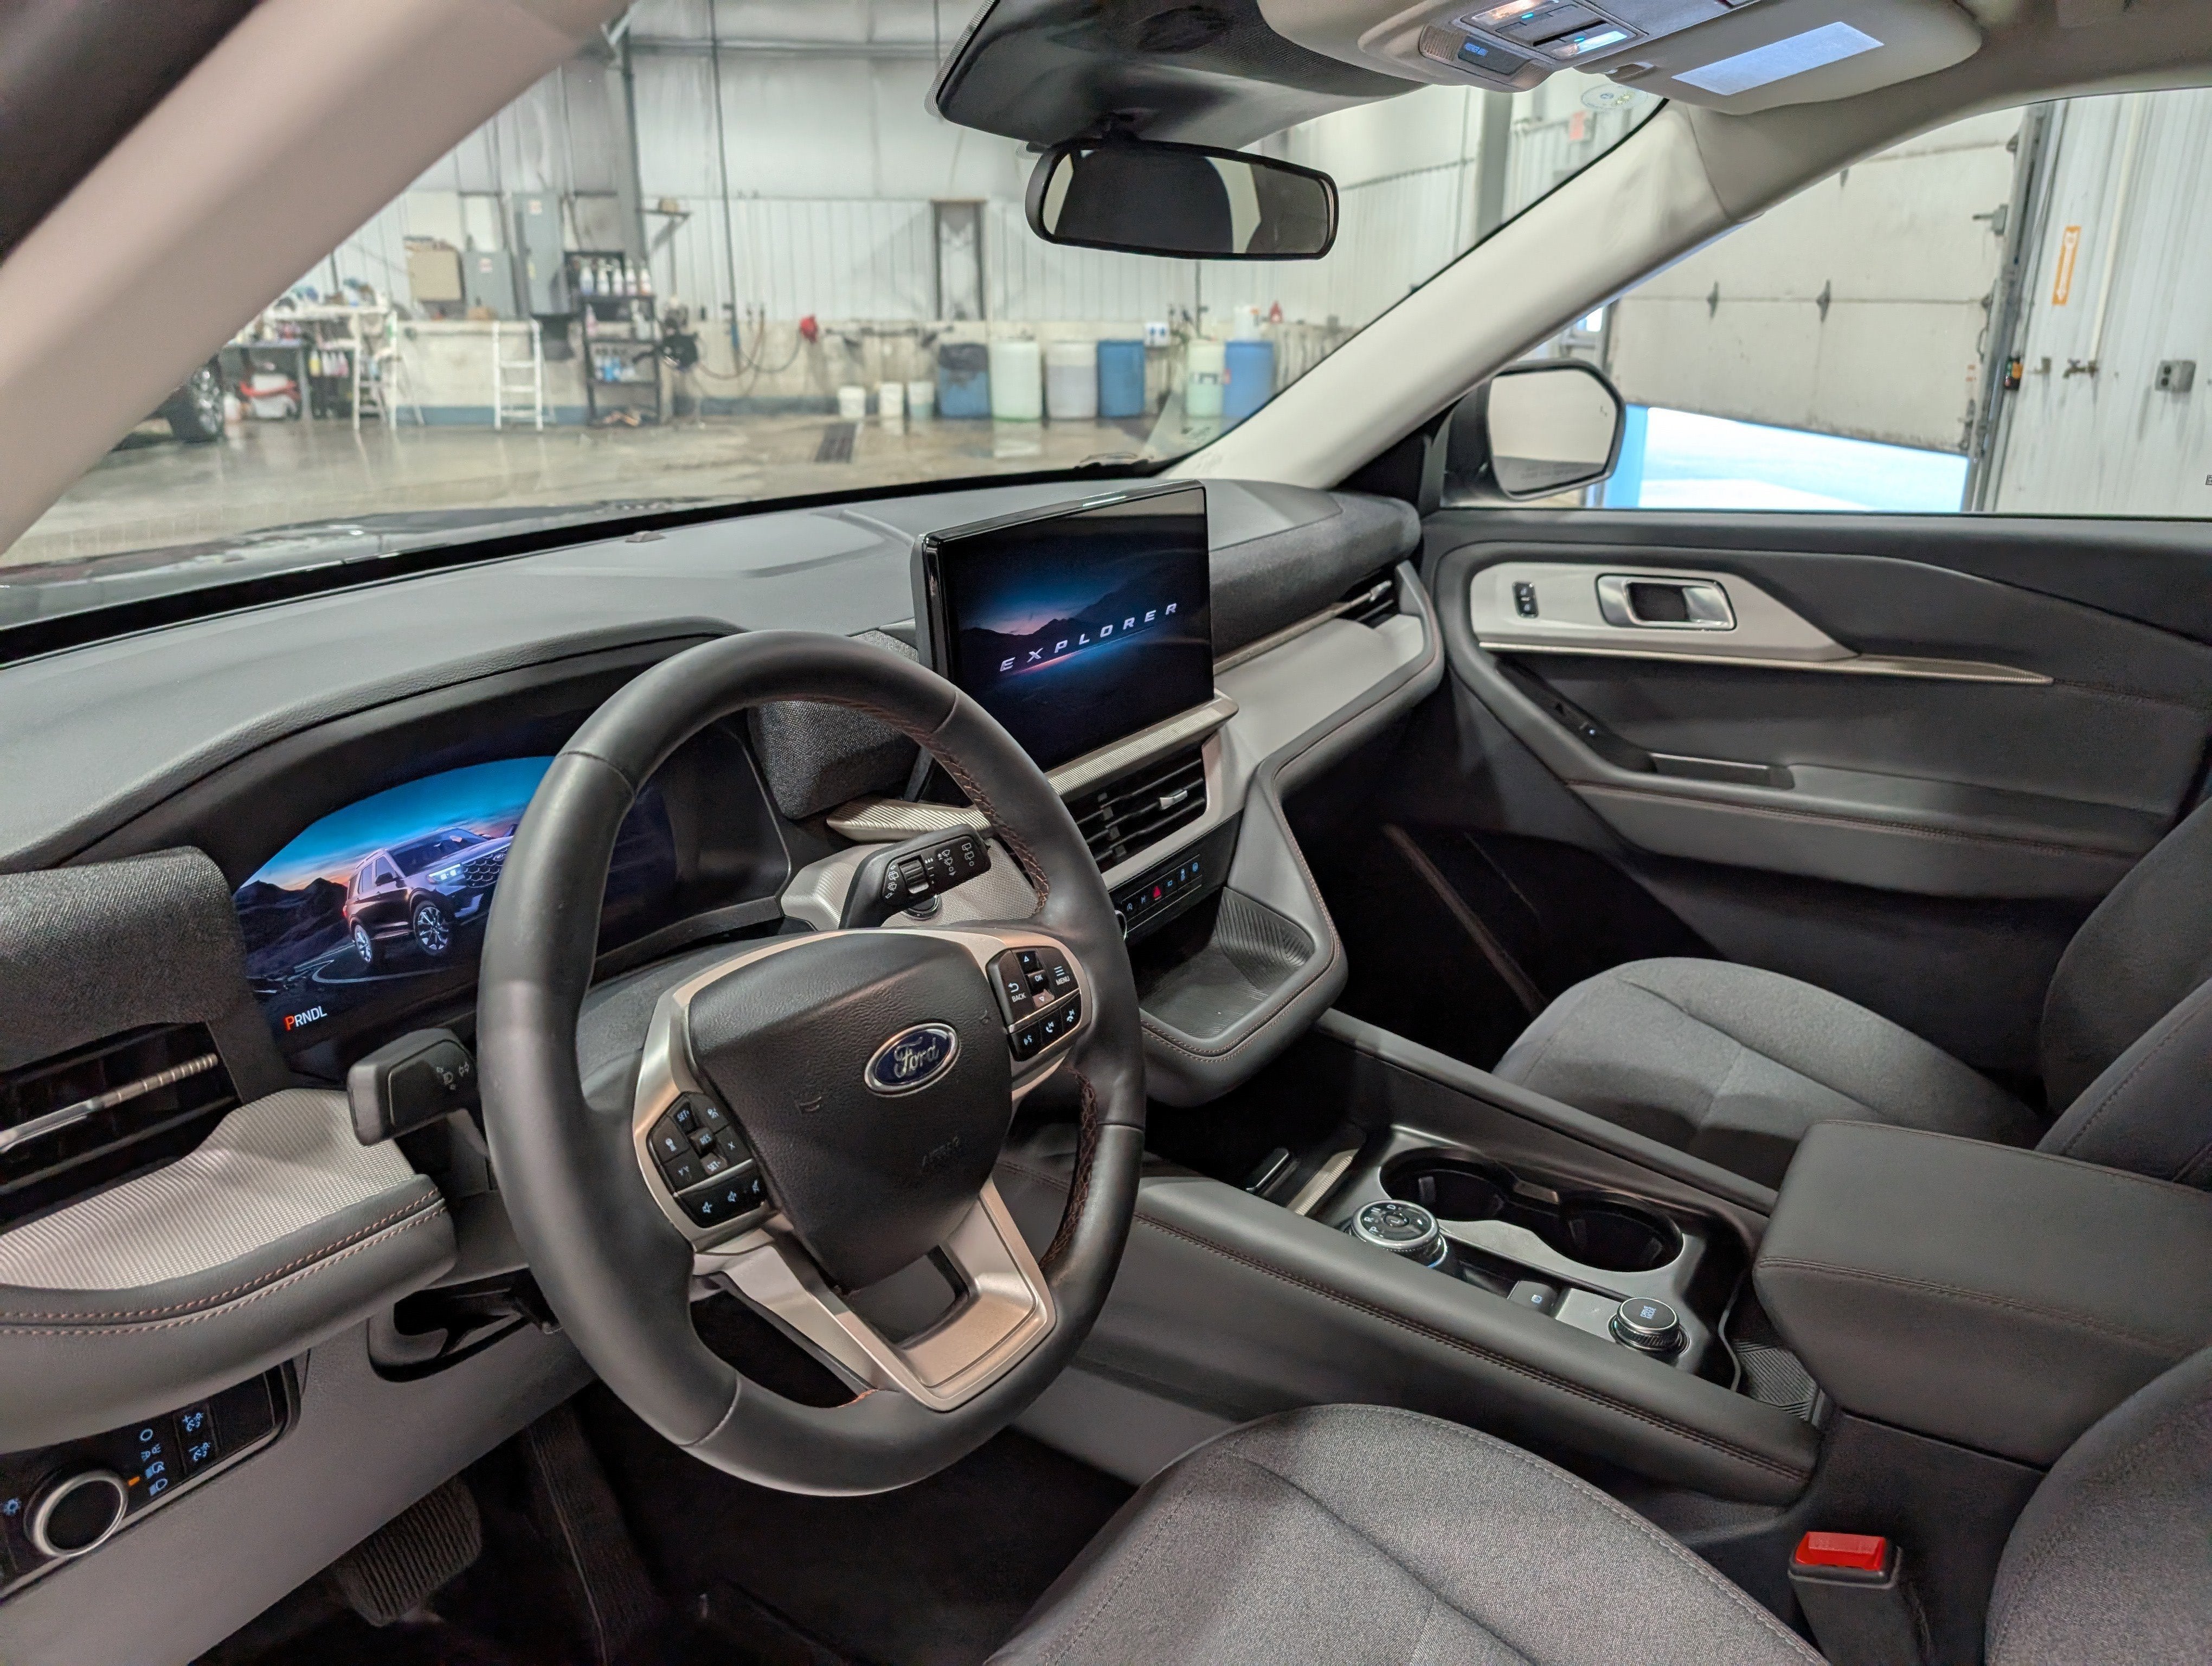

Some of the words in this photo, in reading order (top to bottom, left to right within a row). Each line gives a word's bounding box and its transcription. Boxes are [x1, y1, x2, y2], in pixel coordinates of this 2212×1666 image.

[999, 602, 1178, 672] EXPLORER
[1034, 974, 1044, 982] OK
[1055, 975, 1070, 986] MENU
[1011, 992, 1027, 1003] BACK
[285, 1005, 327, 1031] PRNDL
[893, 1036, 940, 1078] Ford
